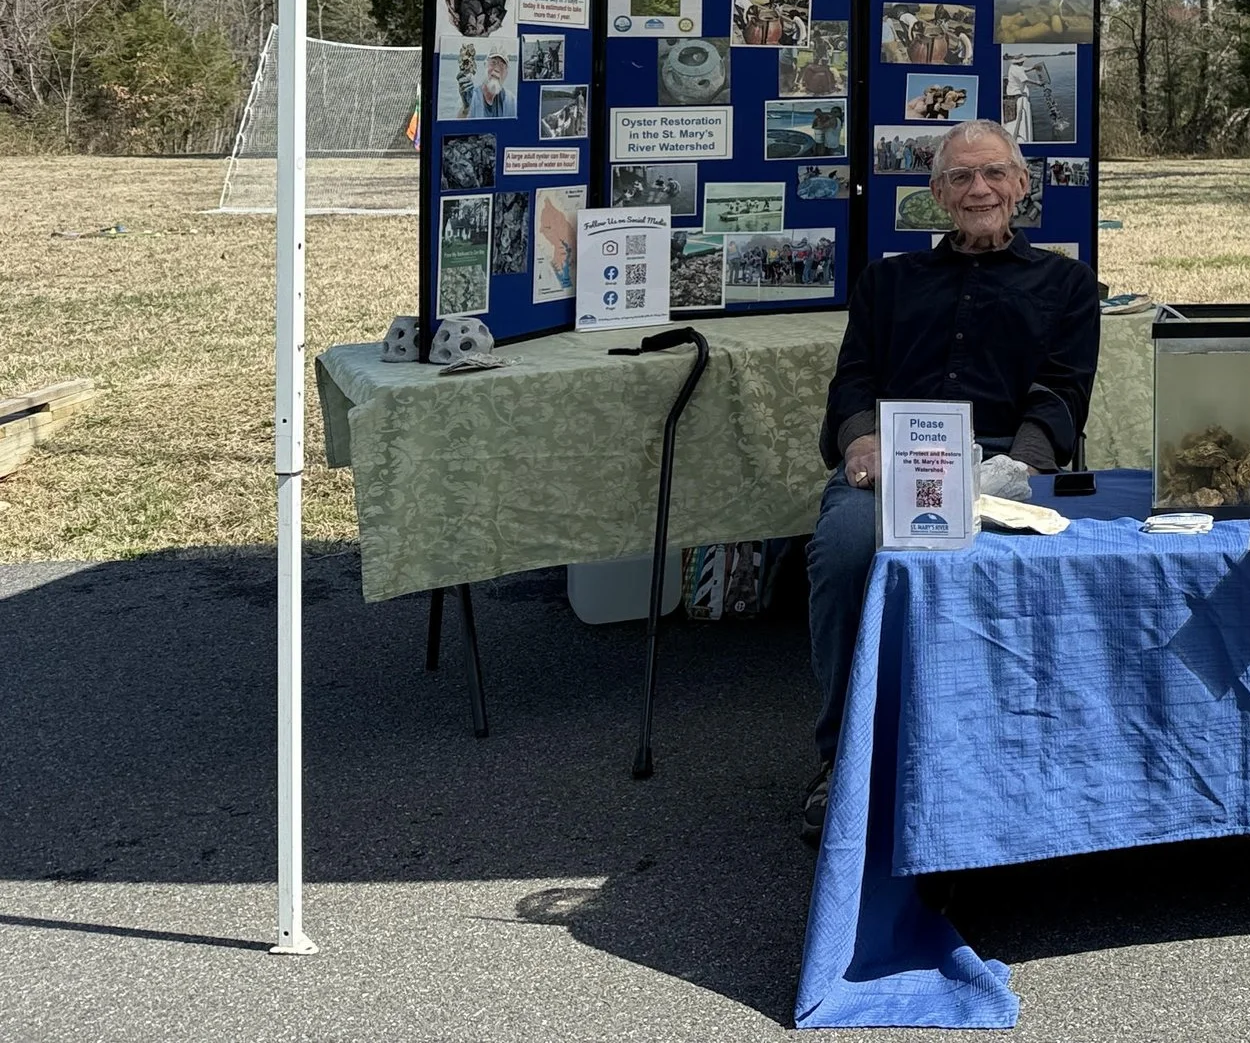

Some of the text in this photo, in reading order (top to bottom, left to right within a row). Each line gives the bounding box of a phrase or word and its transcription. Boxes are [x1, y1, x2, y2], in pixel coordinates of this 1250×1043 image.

[621, 116, 722, 129] Oyster Restoration
[629, 129, 714, 140] in the St. Mary's
[628, 141, 716, 152] River Watershed
[584, 220, 606, 230] Follow
[607, 217, 617, 225] Us
[626, 216, 647, 224] Social
[646, 217, 667, 227] Media
[909, 418, 944, 429] Please
[910, 431, 947, 442] Donate
